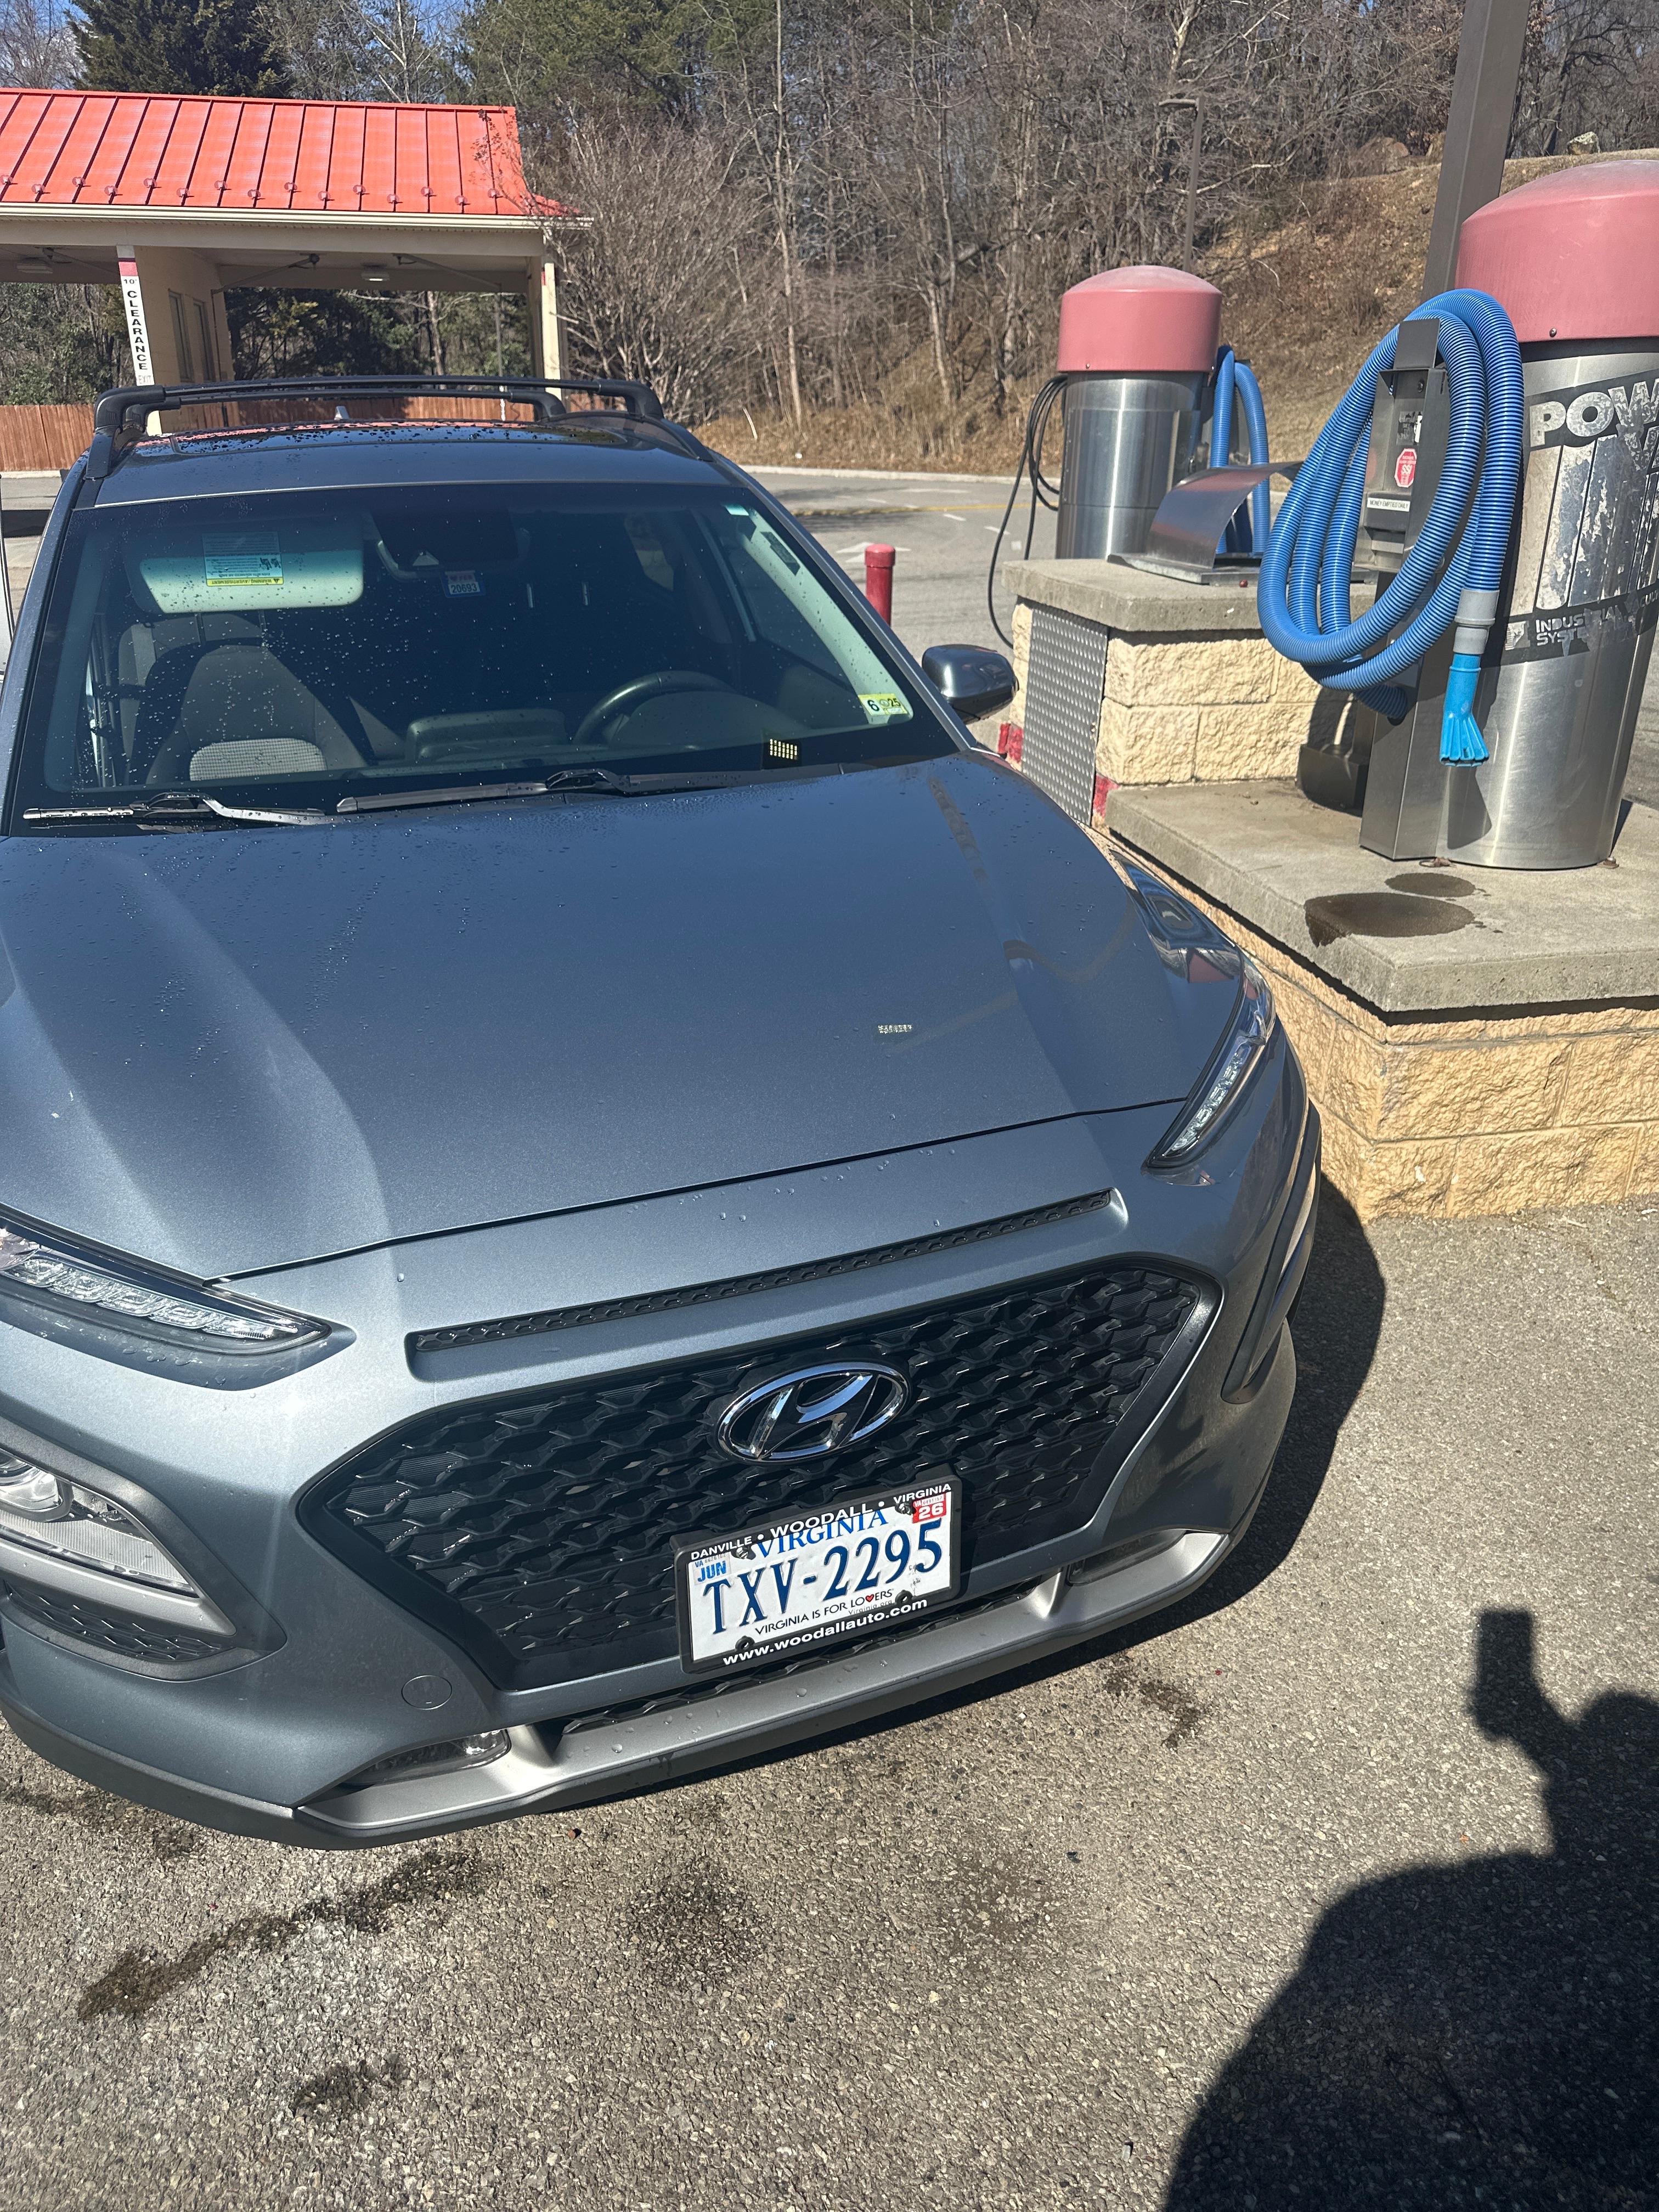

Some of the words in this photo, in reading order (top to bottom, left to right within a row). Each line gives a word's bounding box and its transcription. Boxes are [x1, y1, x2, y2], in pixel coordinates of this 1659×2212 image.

[127, 290, 148, 370] CLEARANCE
[451, 584, 477, 592] 20693
[867, 699, 879, 712] 6
[888, 698, 901, 707] 25
[691, 1536, 752, 1560] DANVILLE
[770, 1503, 873, 1538] WOODALL
[894, 1483, 951, 1504] VIRGINIA
[918, 1502, 944, 1520] 26
[757, 1510, 889, 1558] VIRGINIA
[697, 1560, 726, 1582] JUN
[702, 1518, 943, 1634] TXV-2295
[723, 1599, 928, 1665] www.woodallauto.com
[755, 1612, 809, 1635] VIRGINIA
[812, 1609, 821, 1620] IS
[824, 1602, 847, 1616] FOR
